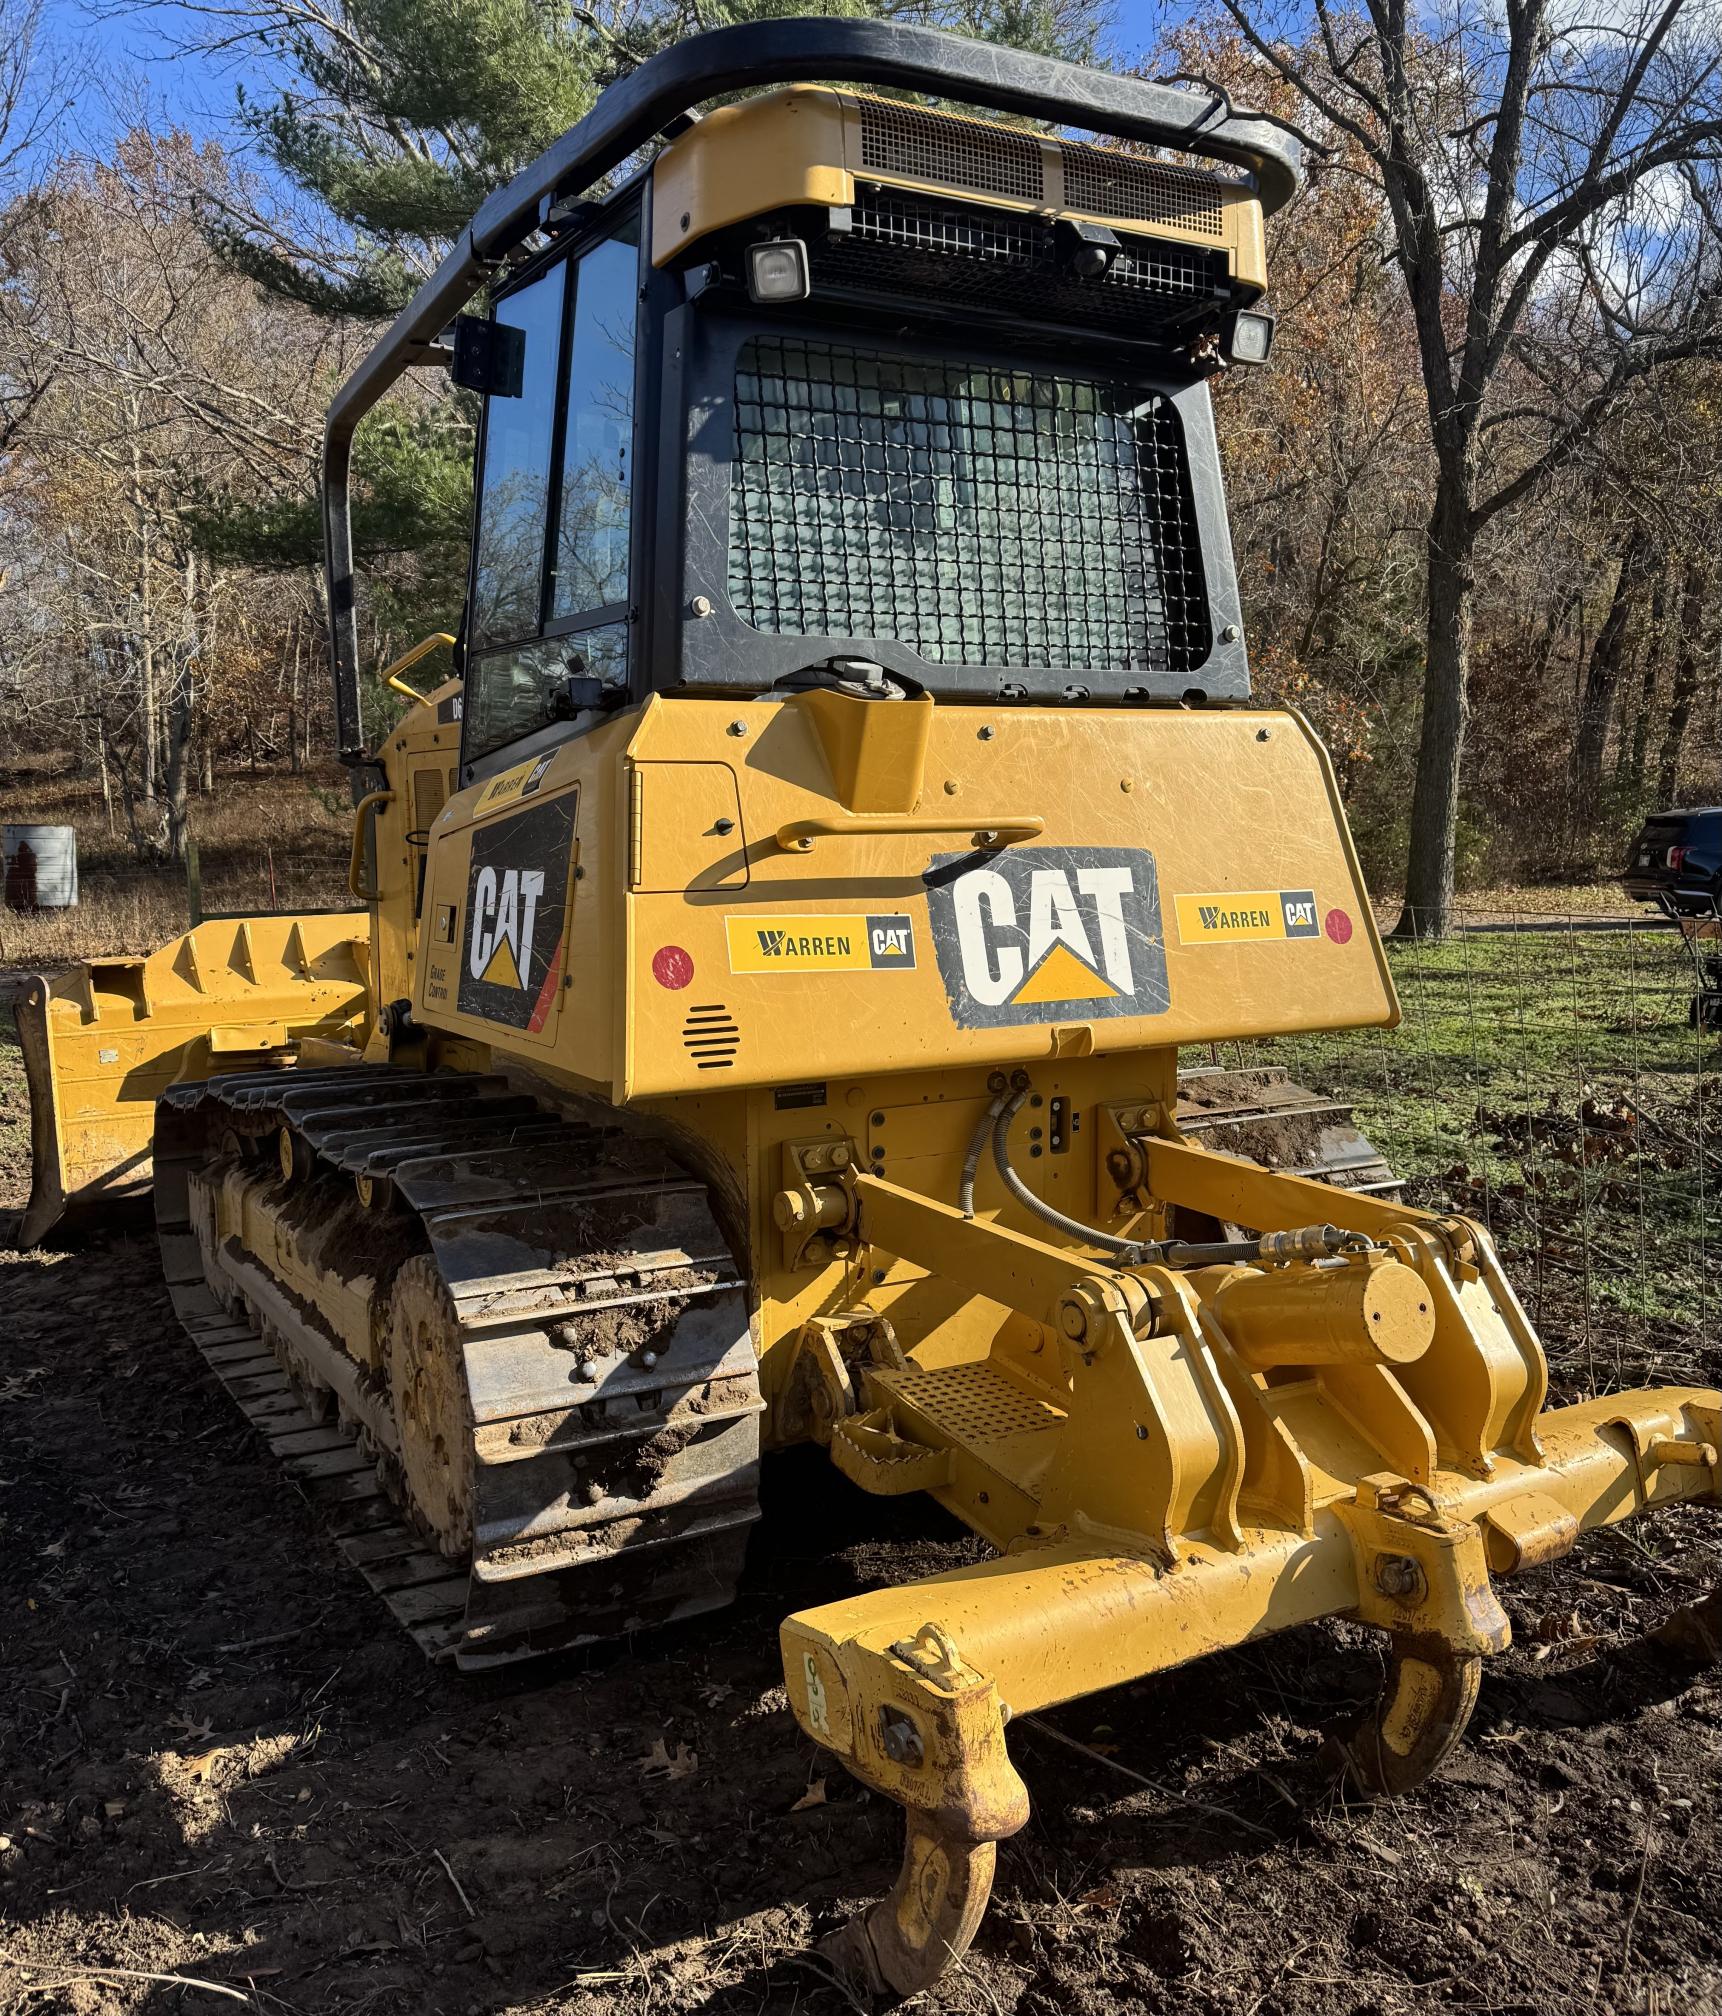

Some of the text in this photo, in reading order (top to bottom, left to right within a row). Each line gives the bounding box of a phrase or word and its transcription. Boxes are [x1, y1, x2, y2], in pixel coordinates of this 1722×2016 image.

[527, 758, 552, 783] CAT
[470, 865, 545, 991] CAT
[1199, 903, 1315, 931] WARREN CAT
[757, 929, 910, 957] WARREN CAT
[953, 867, 1135, 1006] CAT
